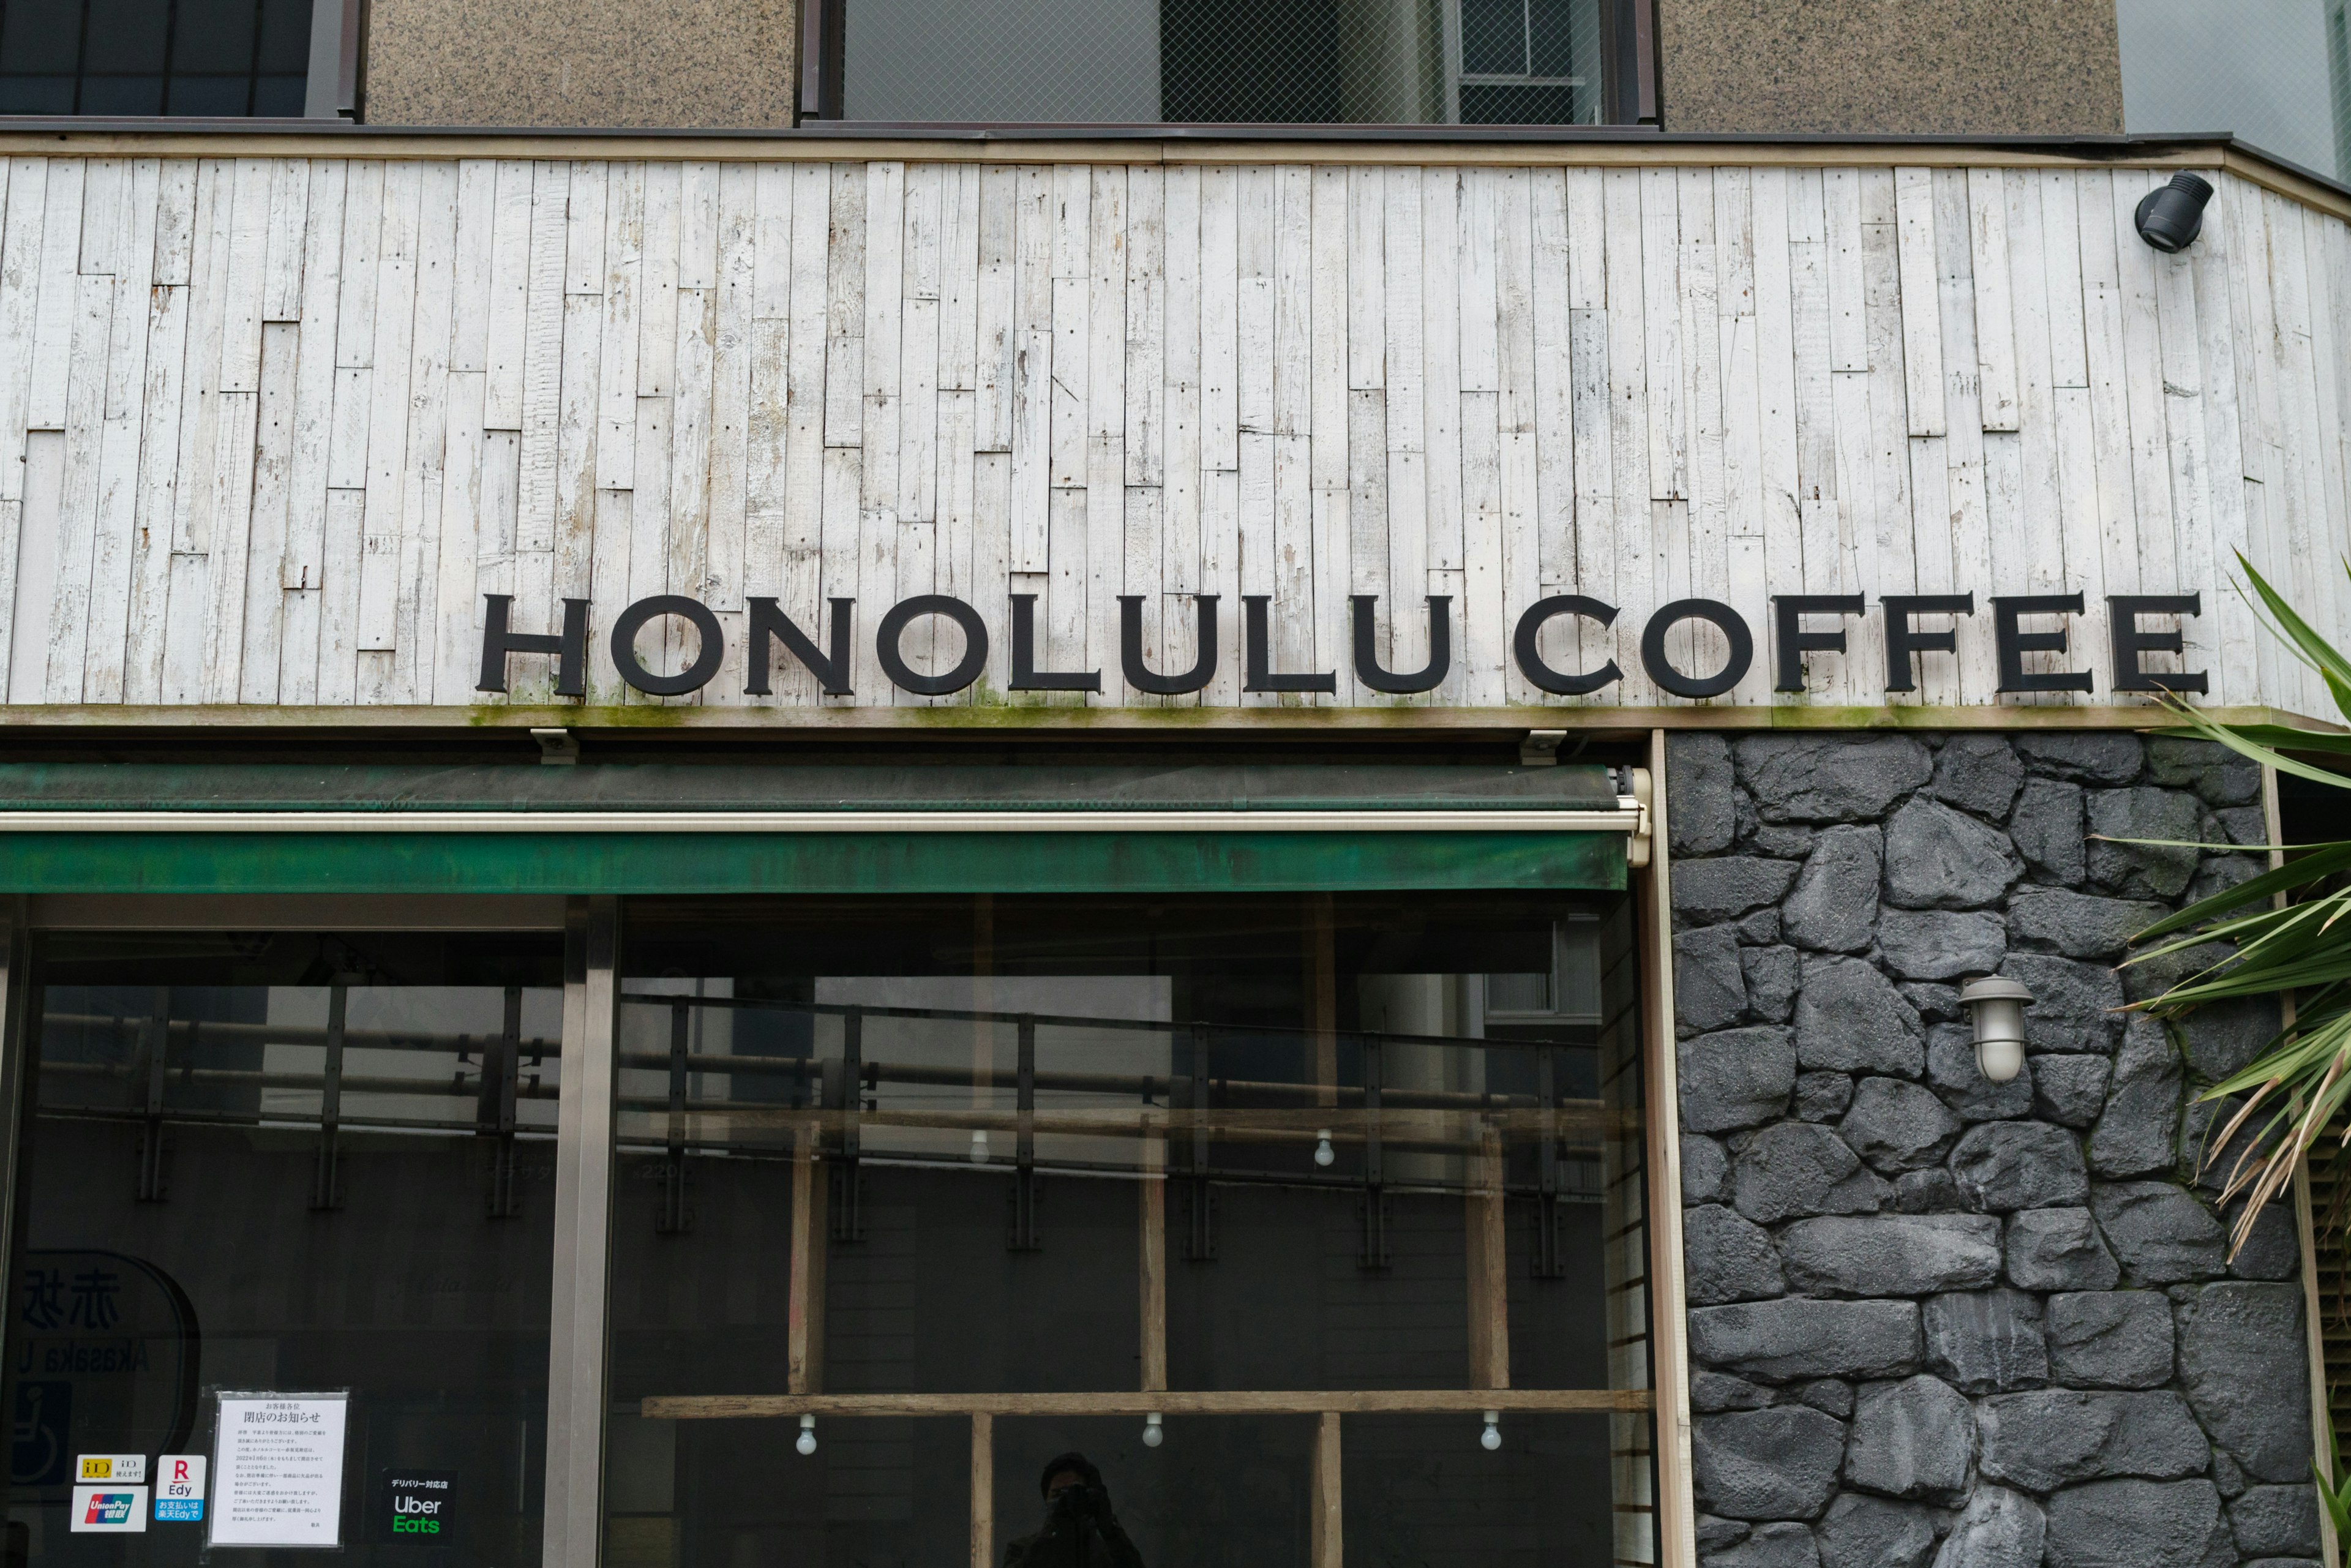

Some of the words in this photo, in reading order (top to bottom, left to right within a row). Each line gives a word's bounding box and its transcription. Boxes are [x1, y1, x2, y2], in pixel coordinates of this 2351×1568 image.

[475, 593, 1453, 697] HONOLULU
[1512, 590, 2209, 699] COFFEE
[244, 1411, 320, 1424] 閉店のお知らせ
[85, 1461, 110, 1474] iD
[174, 1460, 189, 1479] R
[392, 1479, 448, 1489] デリバリー対応店
[169, 1485, 192, 1497] Edy
[91, 1500, 130, 1512] UnionPay
[395, 1496, 441, 1514] Uber
[158, 1510, 199, 1520] 楽天Edyで
[393, 1515, 440, 1534] Eats
